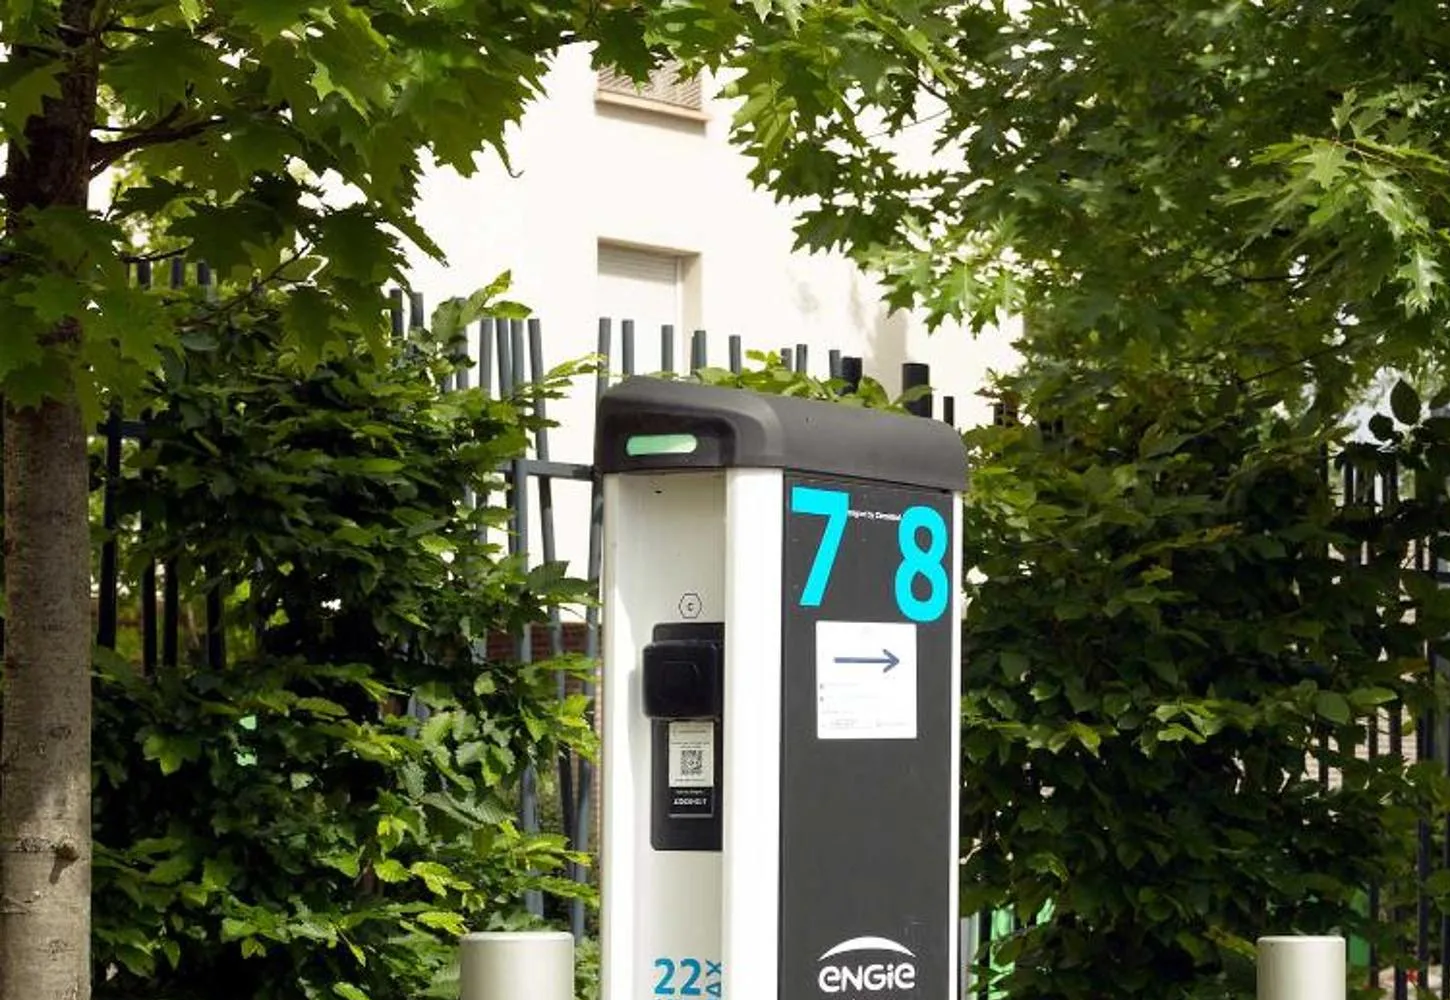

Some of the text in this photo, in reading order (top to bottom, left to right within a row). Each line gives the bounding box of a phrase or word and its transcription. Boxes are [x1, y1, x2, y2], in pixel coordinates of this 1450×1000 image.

[790, 485, 950, 623] 7 8
[654, 957, 701, 996] 22
